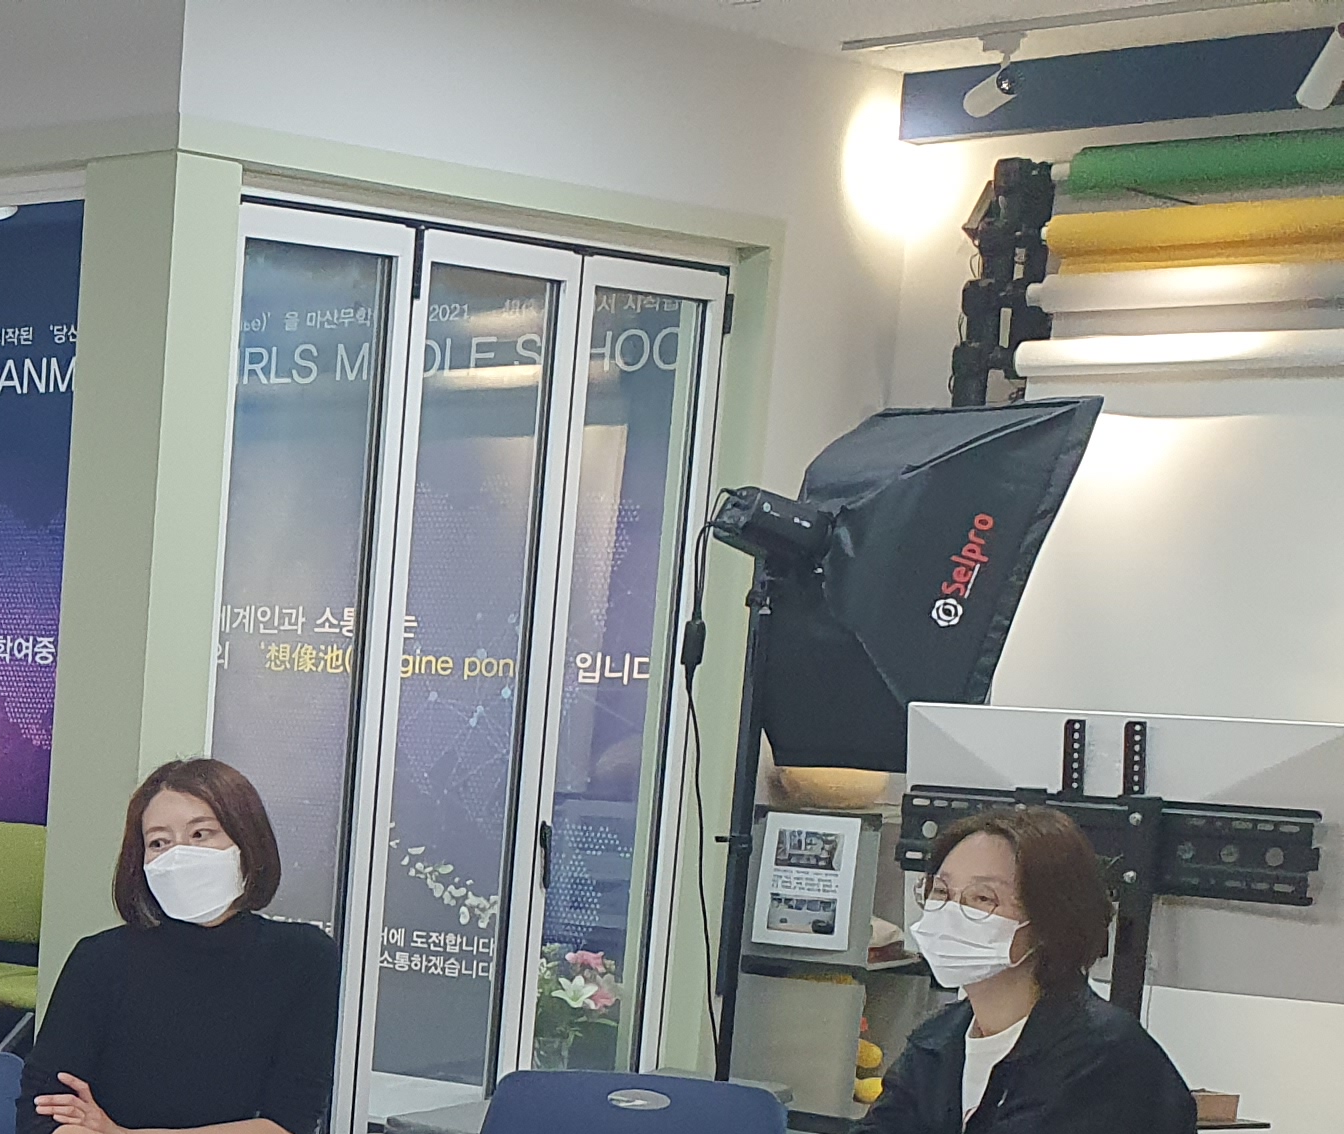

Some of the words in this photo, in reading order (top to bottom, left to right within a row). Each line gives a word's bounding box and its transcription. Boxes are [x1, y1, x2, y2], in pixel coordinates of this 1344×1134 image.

[284, 311, 300, 331] 을
[428, 303, 469, 321] 2021
[941, 513, 994, 597] Selpro
[411, 930, 495, 957] 도전합니다
[379, 950, 494, 981] 소통하겠습니다
